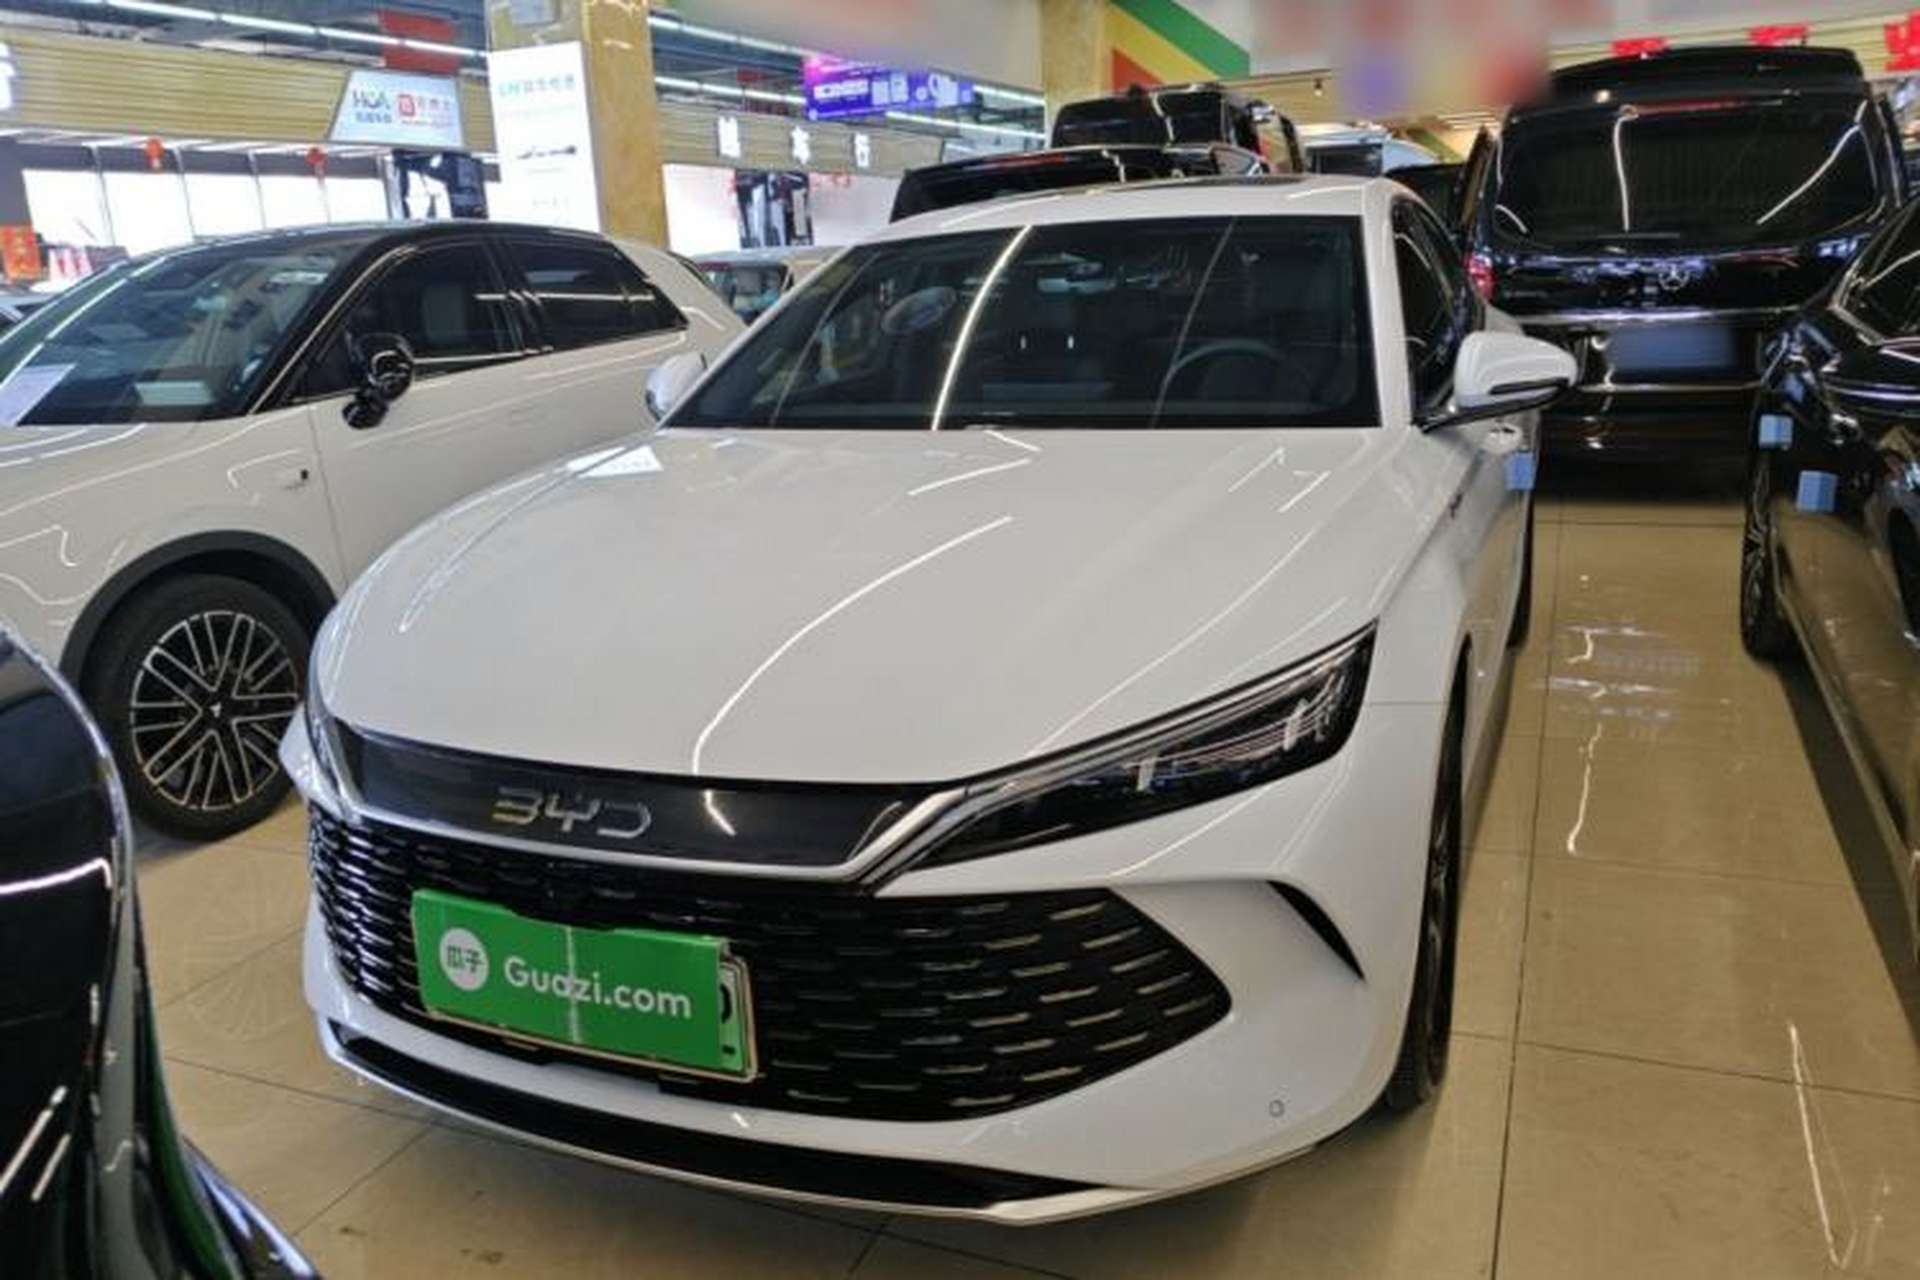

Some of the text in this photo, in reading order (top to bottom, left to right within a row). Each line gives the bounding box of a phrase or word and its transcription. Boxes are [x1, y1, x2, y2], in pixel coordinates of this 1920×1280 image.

[492, 787, 651, 838] BYD
[447, 945, 483, 973] 瓜子
[504, 956, 692, 1019] Guazi.com
